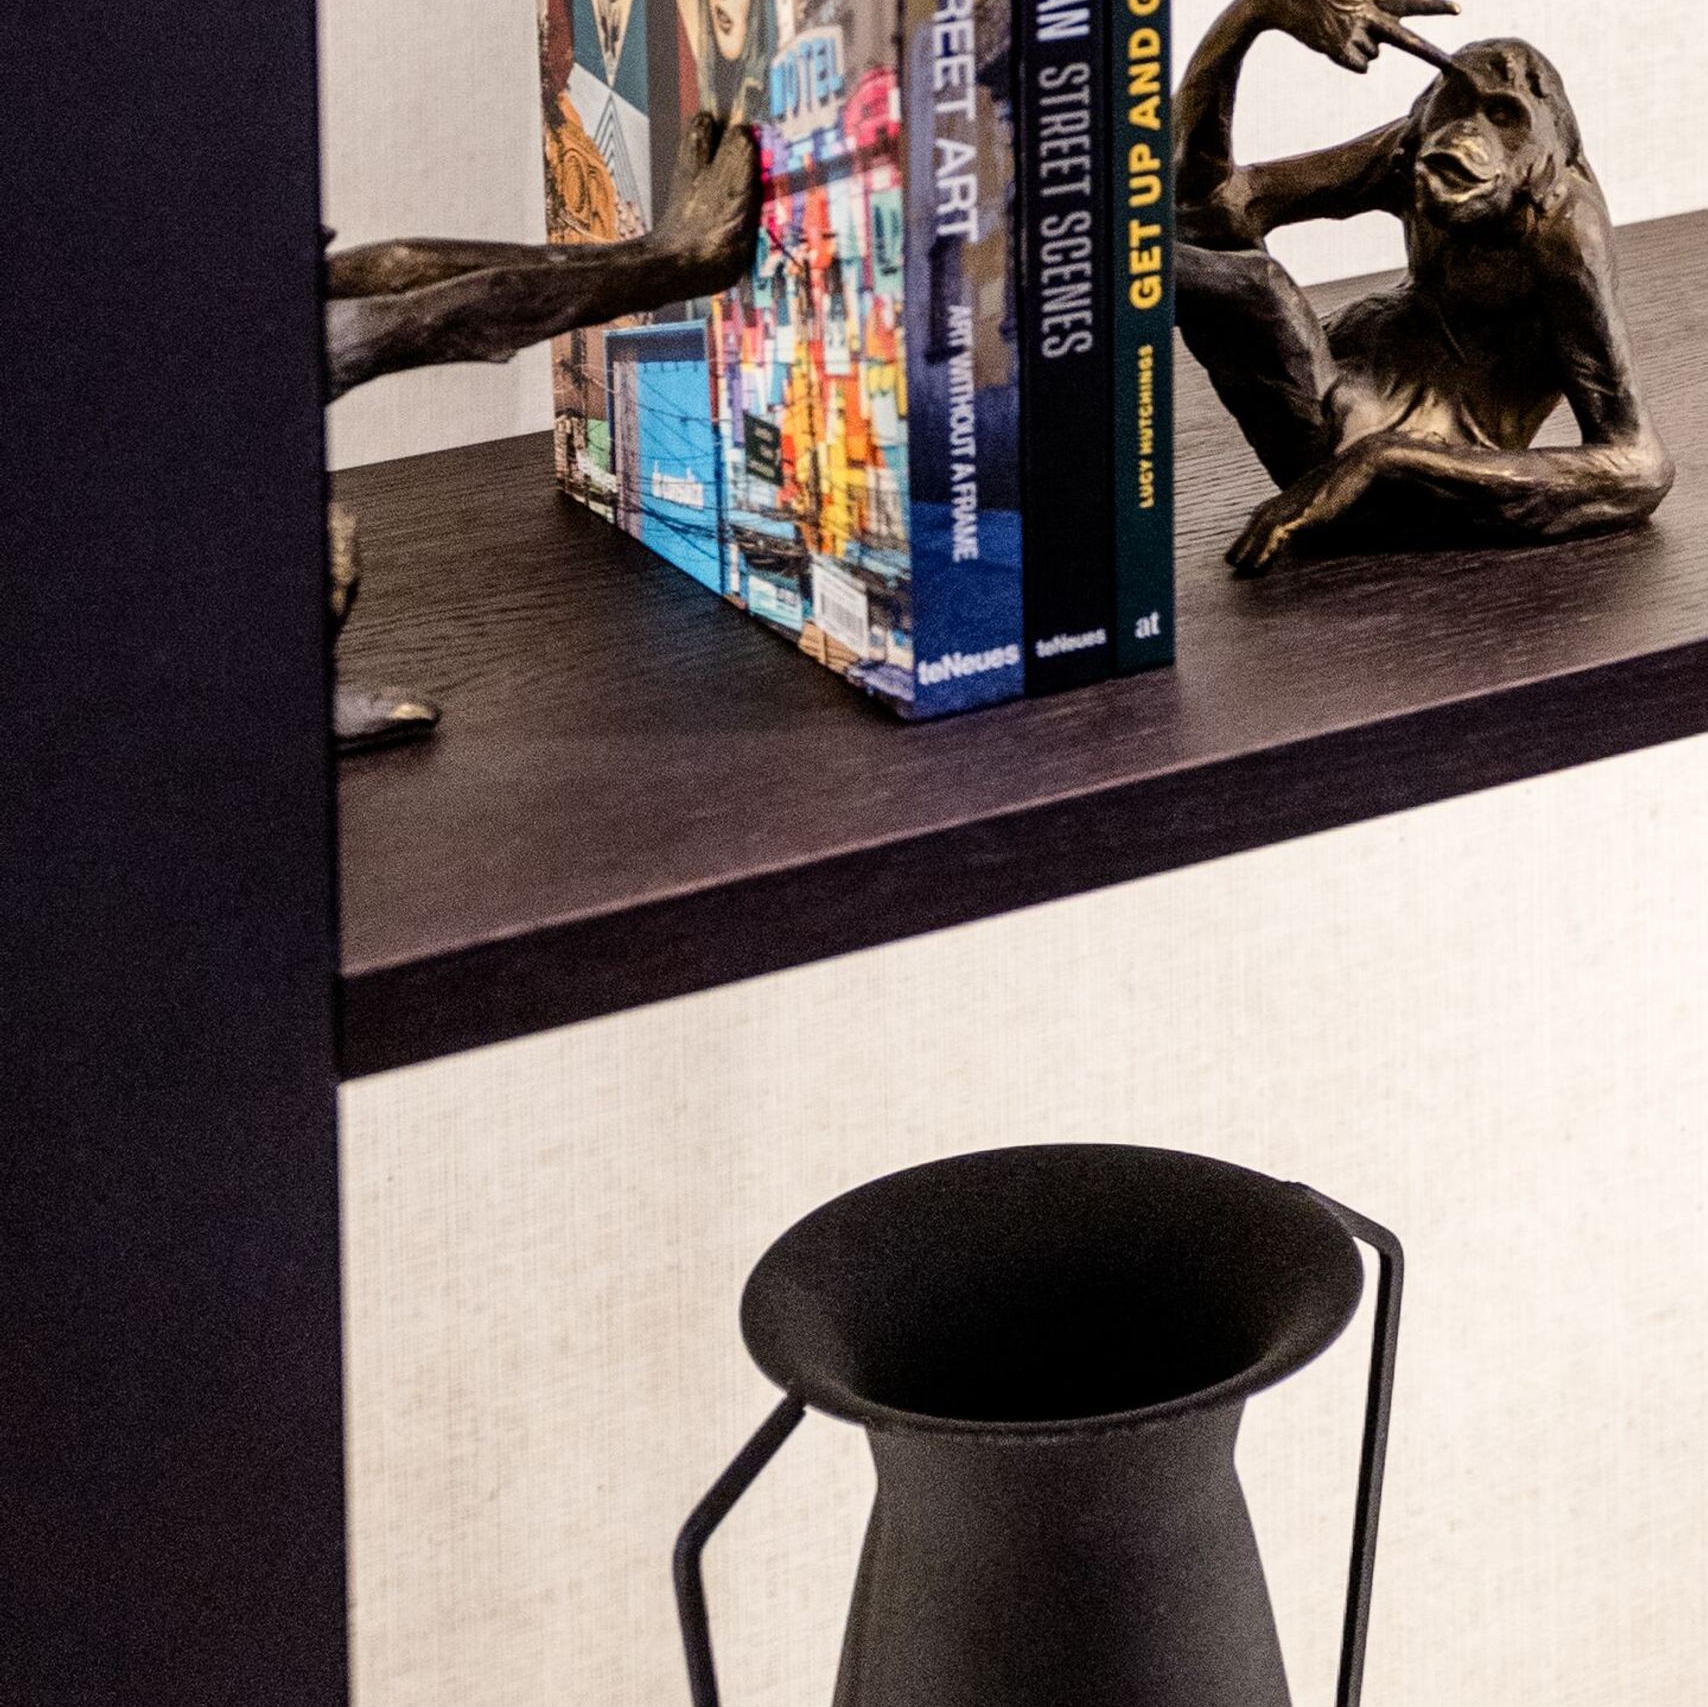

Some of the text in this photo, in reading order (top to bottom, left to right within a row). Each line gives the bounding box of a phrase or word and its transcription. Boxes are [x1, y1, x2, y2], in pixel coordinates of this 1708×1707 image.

[1129, 27, 1163, 132] AND
[1037, 62, 1091, 204] STREET
[1129, 141, 1163, 206] UP
[934, 138, 980, 243] ART
[1039, 209, 1095, 360] SCENES
[1129, 209, 1163, 311] GET
[947, 303, 980, 563] ART WITHOUT A FRAME
[1136, 343, 1155, 510] LUCY HUTCHINGS
[1133, 610, 1162, 640] at
